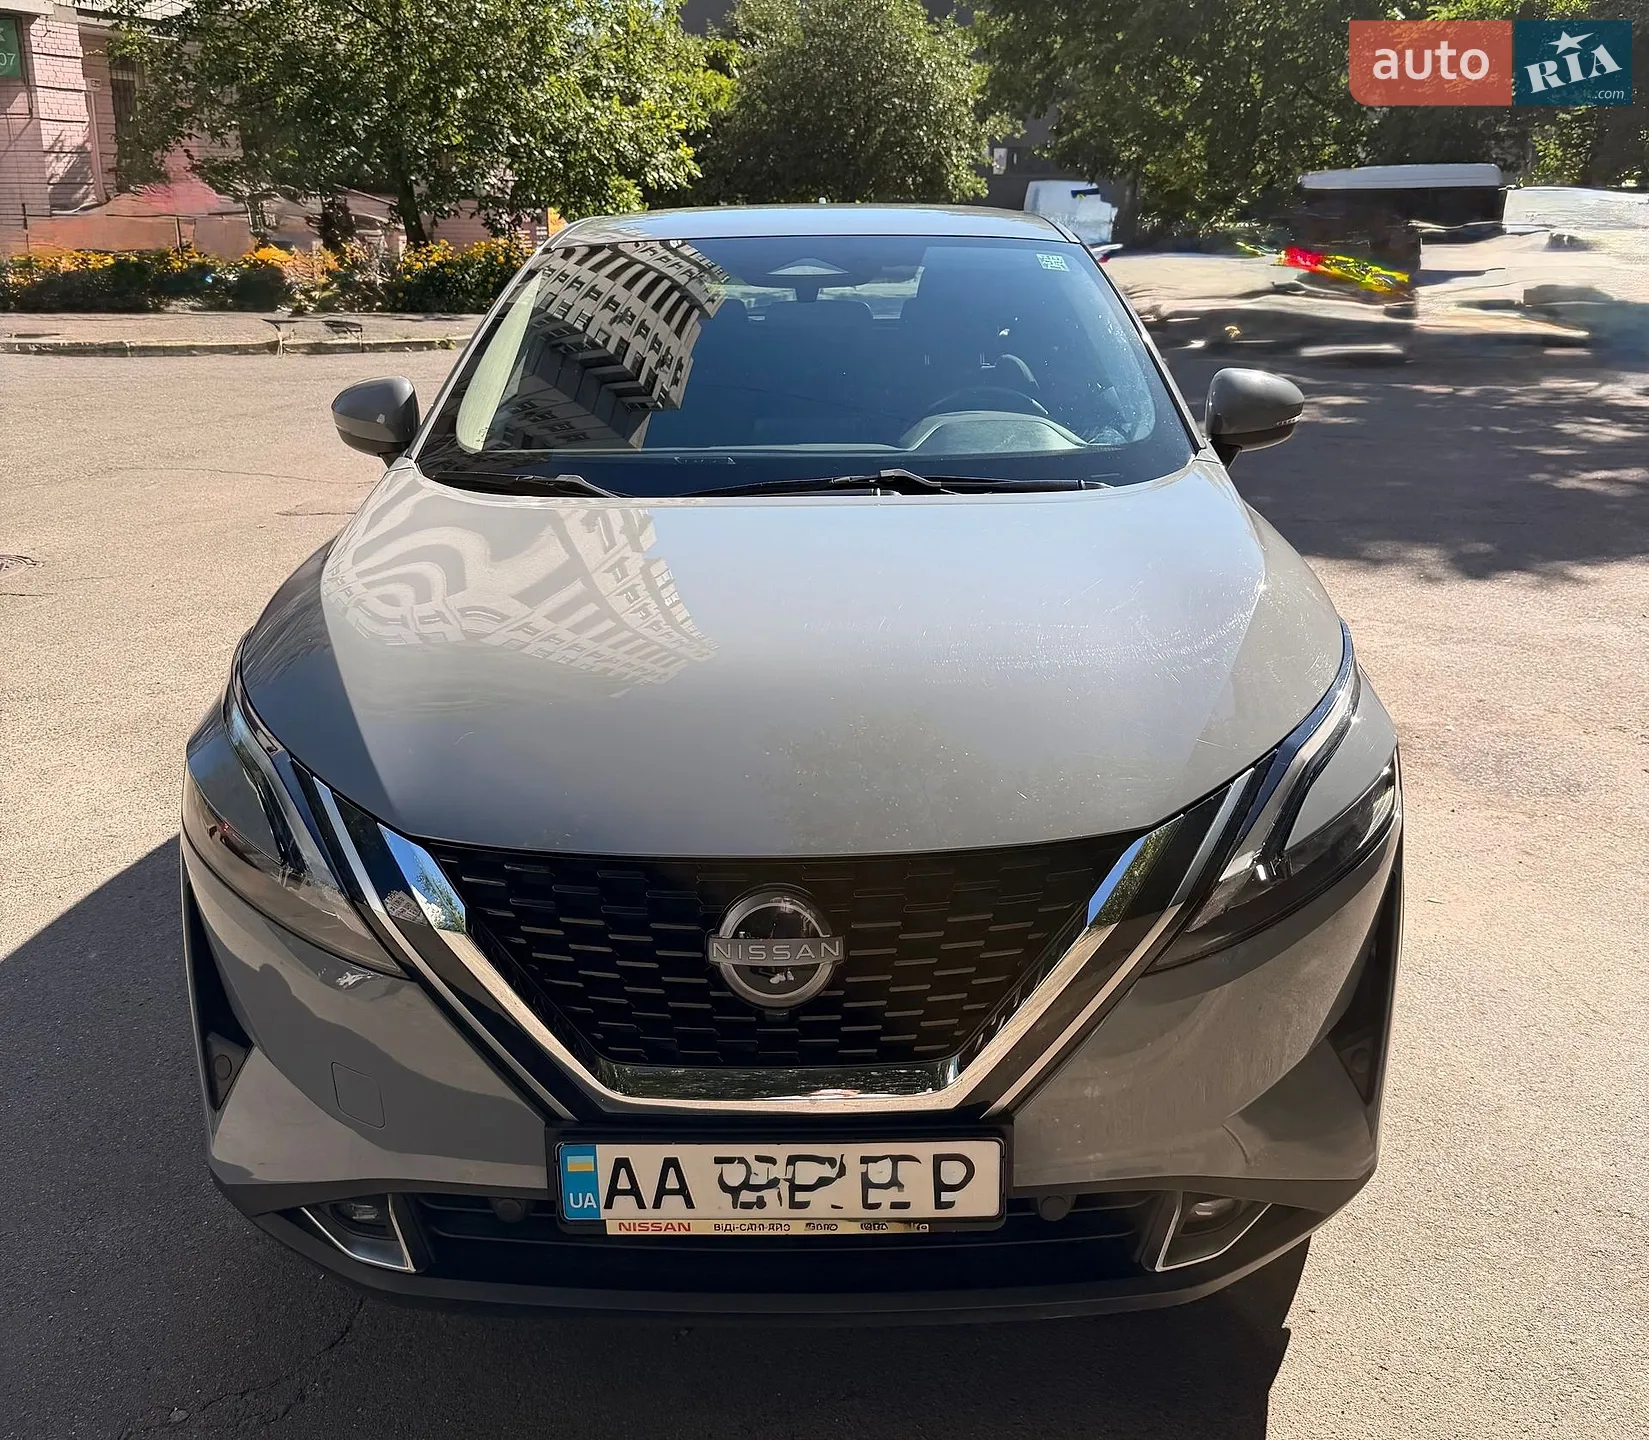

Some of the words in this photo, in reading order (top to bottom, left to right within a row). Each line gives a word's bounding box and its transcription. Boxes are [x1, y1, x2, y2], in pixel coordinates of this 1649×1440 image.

[713, 940, 840, 961] NISSAN
[603, 1156, 696, 1210] AA
[568, 1192, 598, 1209] UA
[618, 1222, 691, 1232] NISSAN
